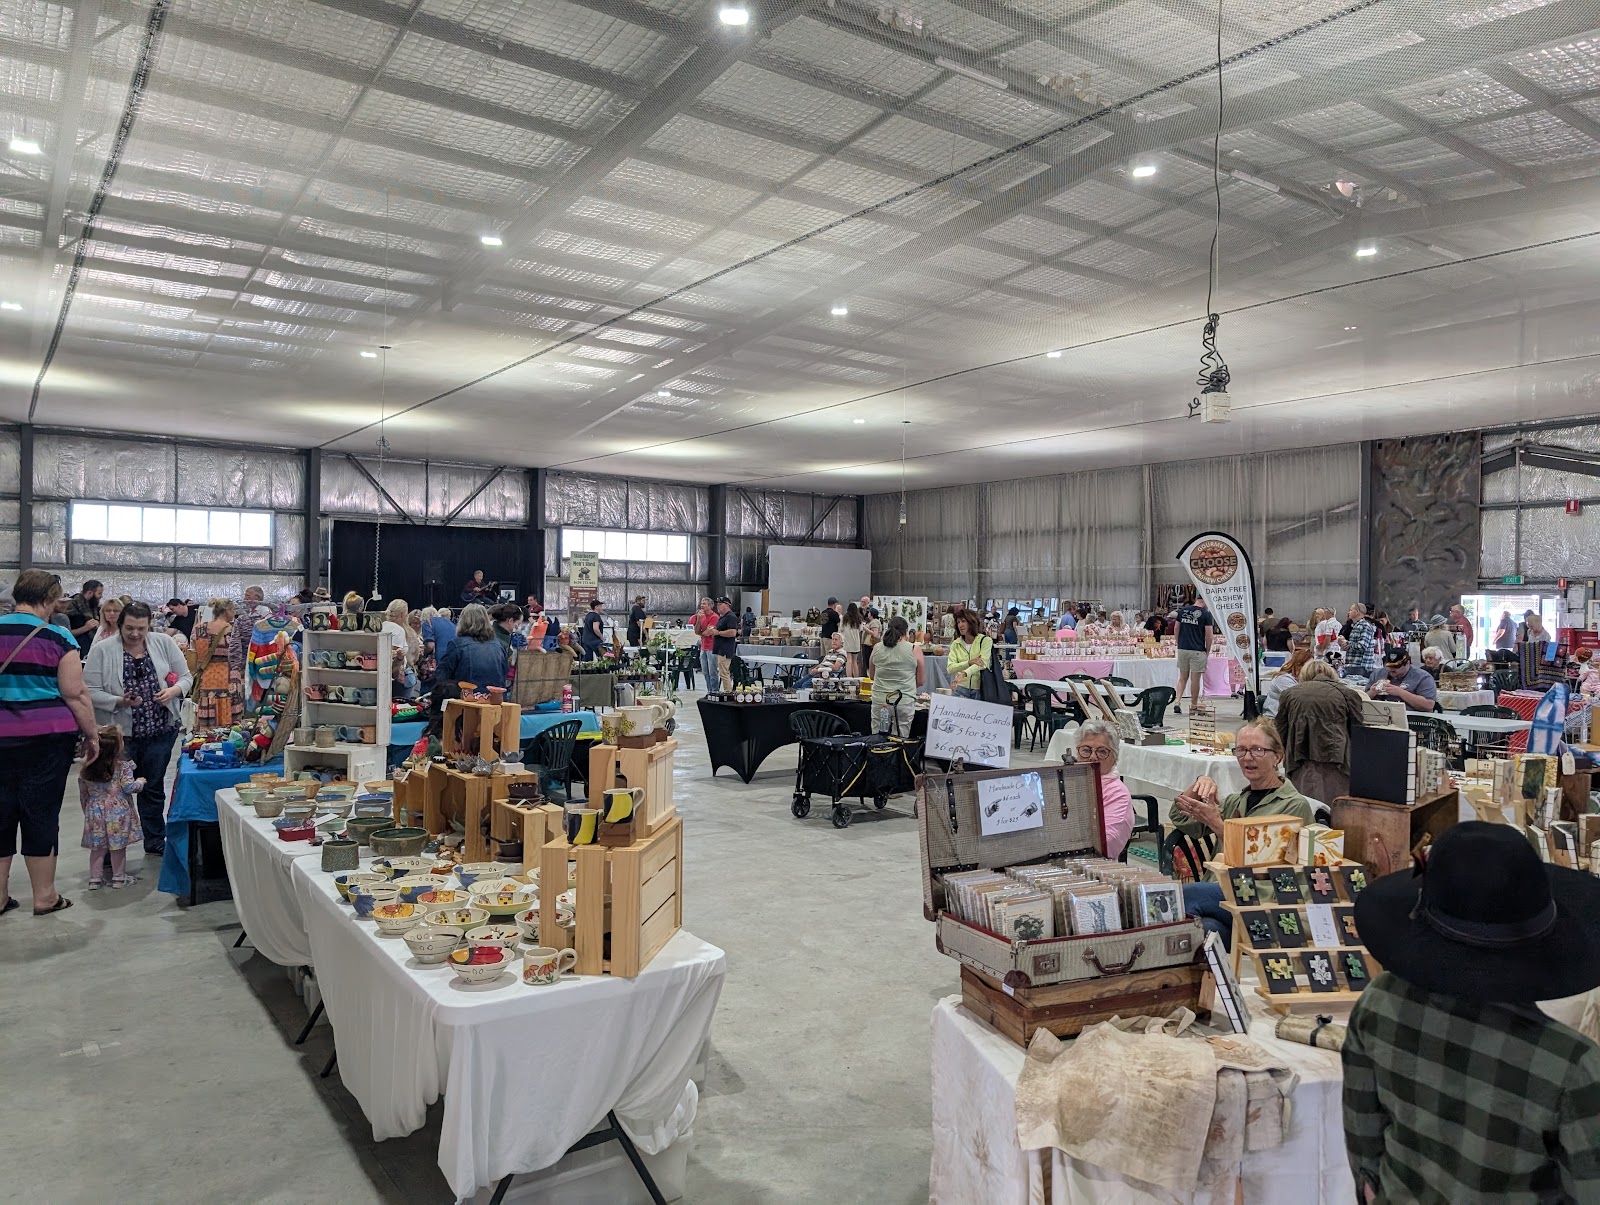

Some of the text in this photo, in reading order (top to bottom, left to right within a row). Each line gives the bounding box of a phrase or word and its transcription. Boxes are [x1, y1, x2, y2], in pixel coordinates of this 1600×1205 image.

[1197, 541, 1227, 552] GOURMET
[1191, 556, 1237, 568] CHOOSE
[1194, 567, 1235, 583] CASHEW CHEESE
[1215, 602, 1244, 610] CHEESE
[932, 704, 1011, 727] Handmade Cards
[956, 726, 998, 741] 5 for $25
[933, 741, 949, 750] $6
[988, 782, 1014, 793] Handmade
[1009, 792, 1021, 801] each
[1001, 816, 1009, 824] for
